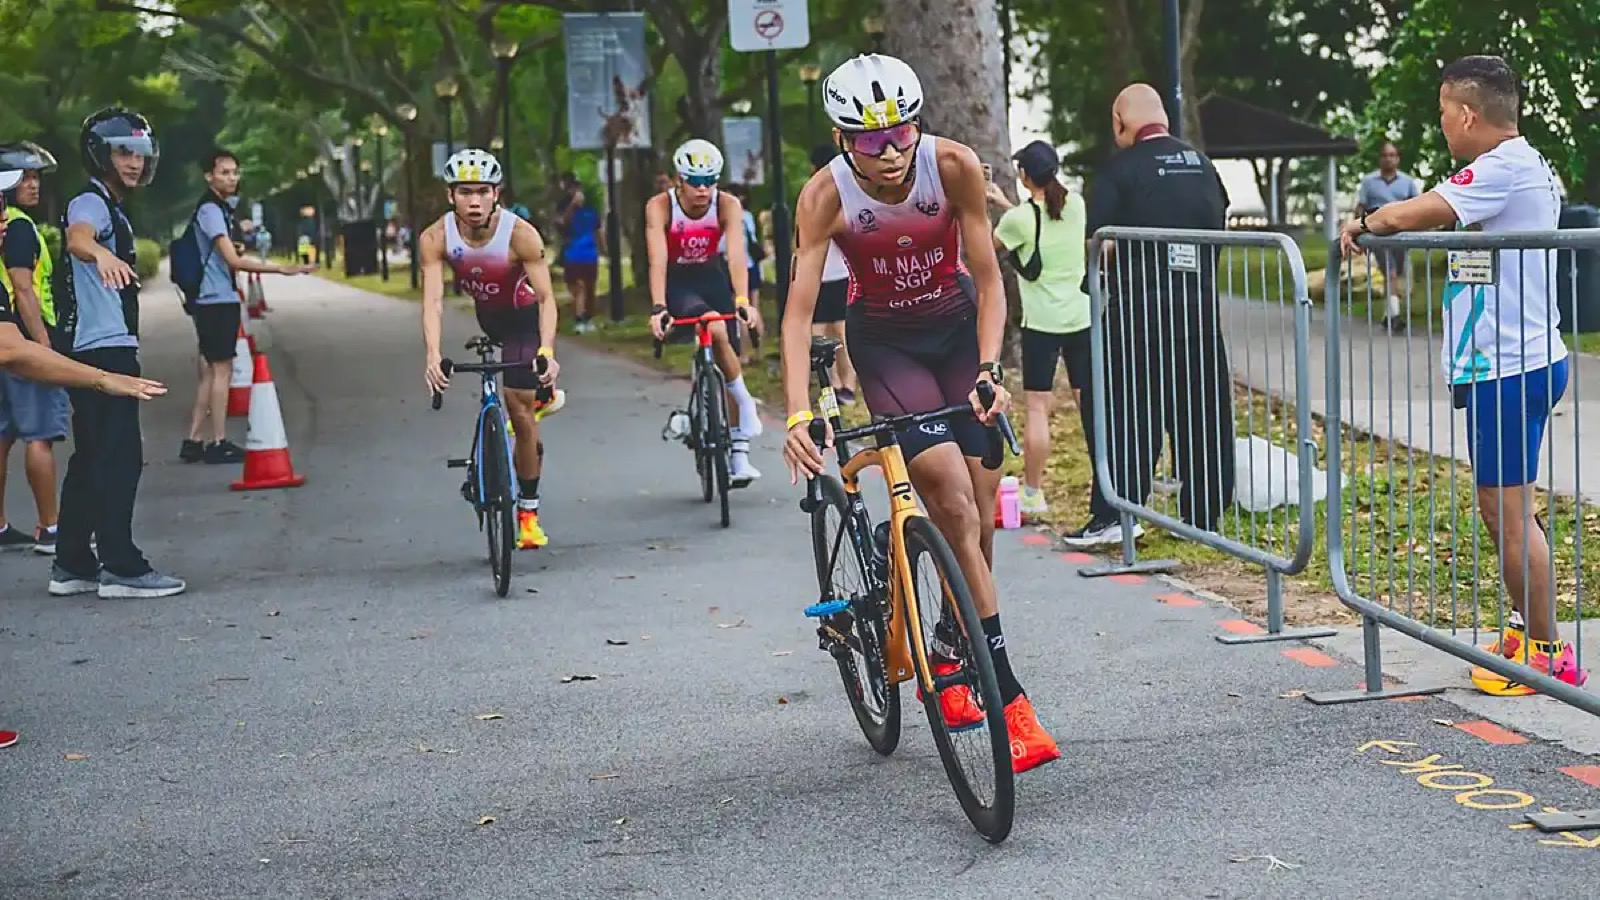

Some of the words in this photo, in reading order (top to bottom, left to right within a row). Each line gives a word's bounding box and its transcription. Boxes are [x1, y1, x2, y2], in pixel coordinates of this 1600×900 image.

[680, 236, 710, 249] LOW
[872, 256, 893, 275] M.
[896, 246, 944, 274] NAJIB
[894, 270, 932, 292] SGP
